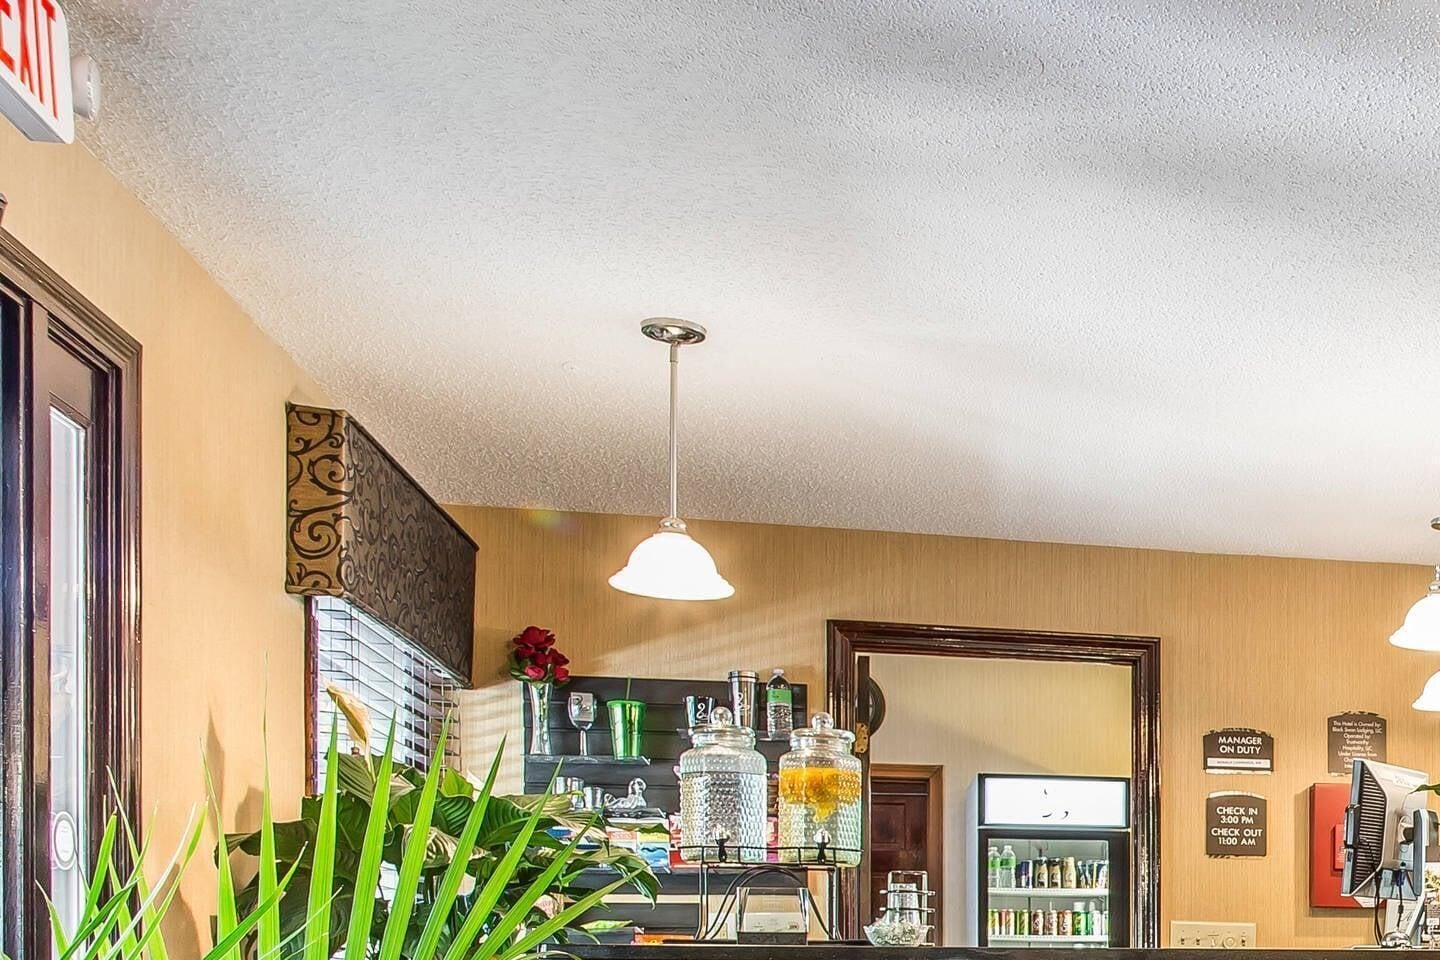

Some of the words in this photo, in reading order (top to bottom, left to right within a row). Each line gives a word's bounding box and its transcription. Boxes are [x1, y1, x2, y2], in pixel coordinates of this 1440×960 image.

[1218, 736, 1262, 745] MANAGER
[1219, 745, 1235, 754] ON
[1237, 746, 1261, 755] DUTY
[1216, 806, 1246, 815] CHECK
[1248, 807, 1258, 816] IN
[1220, 815, 1239, 824] 3:00
[1241, 816, 1254, 824] PM
[1211, 827, 1241, 837] CHECK
[1243, 828, 1263, 837] OUT
[1218, 837, 1238, 846] 11:00
[1240, 838, 1256, 846] AM
